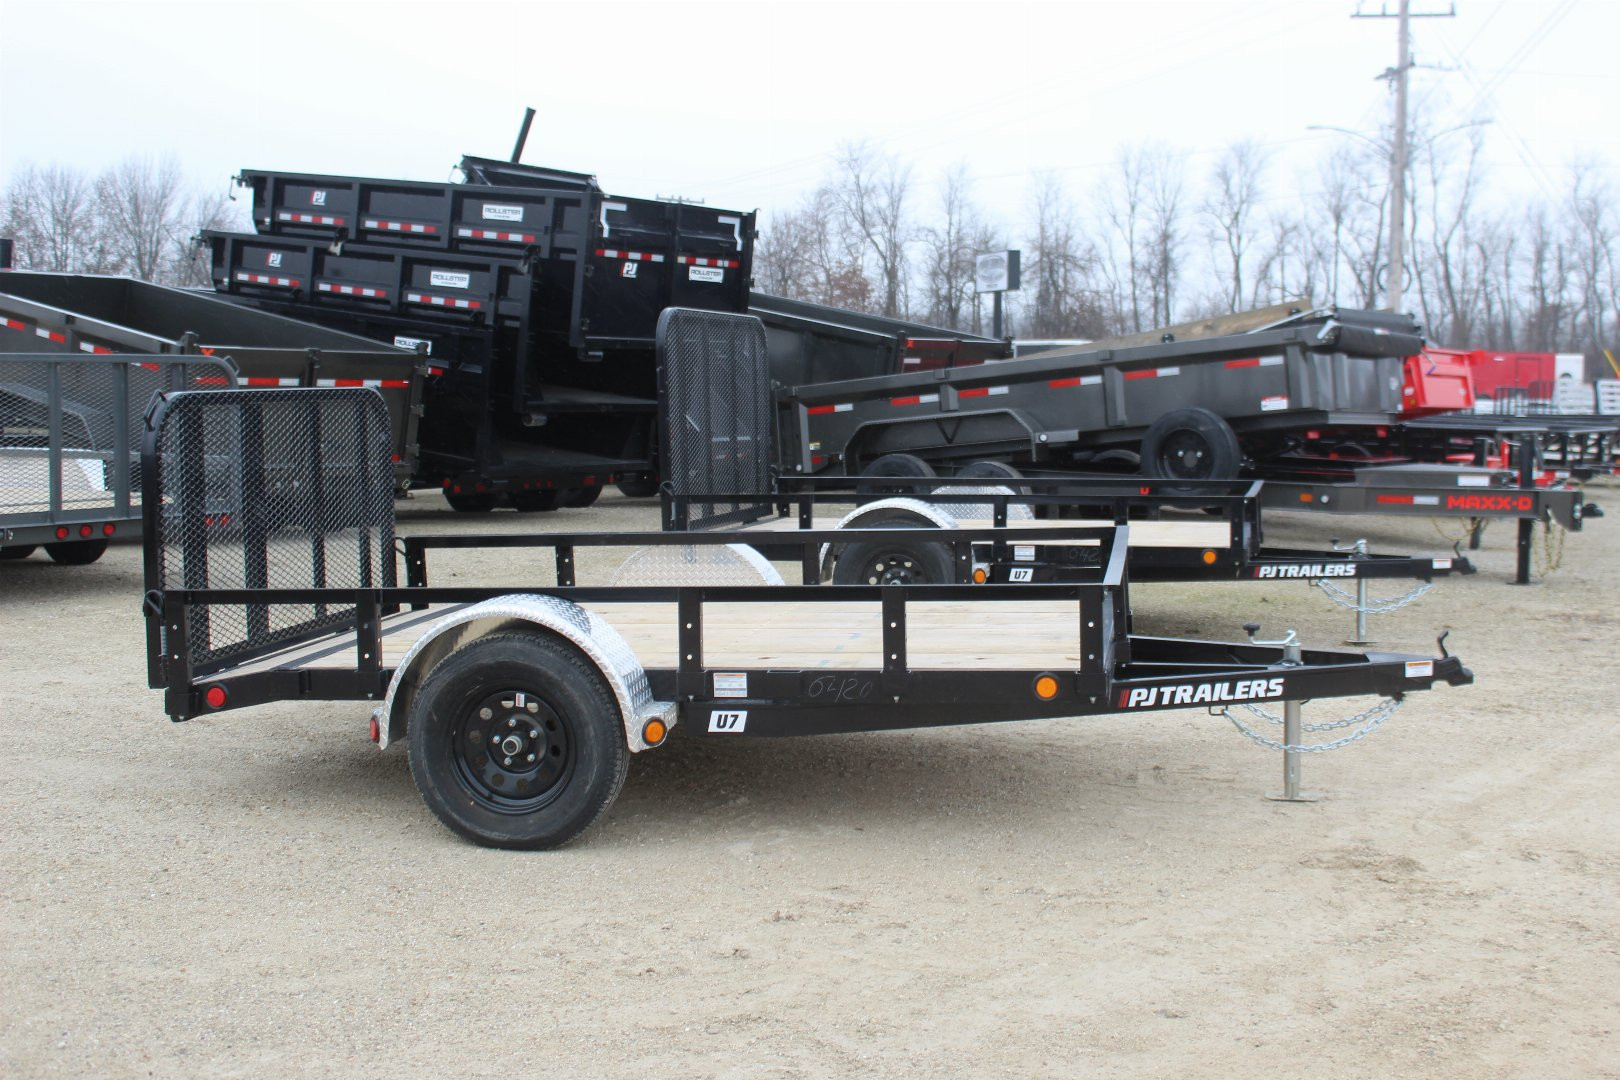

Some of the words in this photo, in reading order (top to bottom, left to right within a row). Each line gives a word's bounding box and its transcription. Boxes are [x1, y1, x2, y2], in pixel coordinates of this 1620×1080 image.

[623, 262, 638, 274] PJ
[1447, 495, 1533, 511] MAXX-D
[1014, 570, 1028, 580] U7
[1259, 565, 1277, 578] PJ
[1278, 564, 1357, 577] TRAILERS
[1128, 688, 1158, 708] PJ
[1160, 678, 1285, 705] TRAILERS
[716, 714, 740, 729] U7
